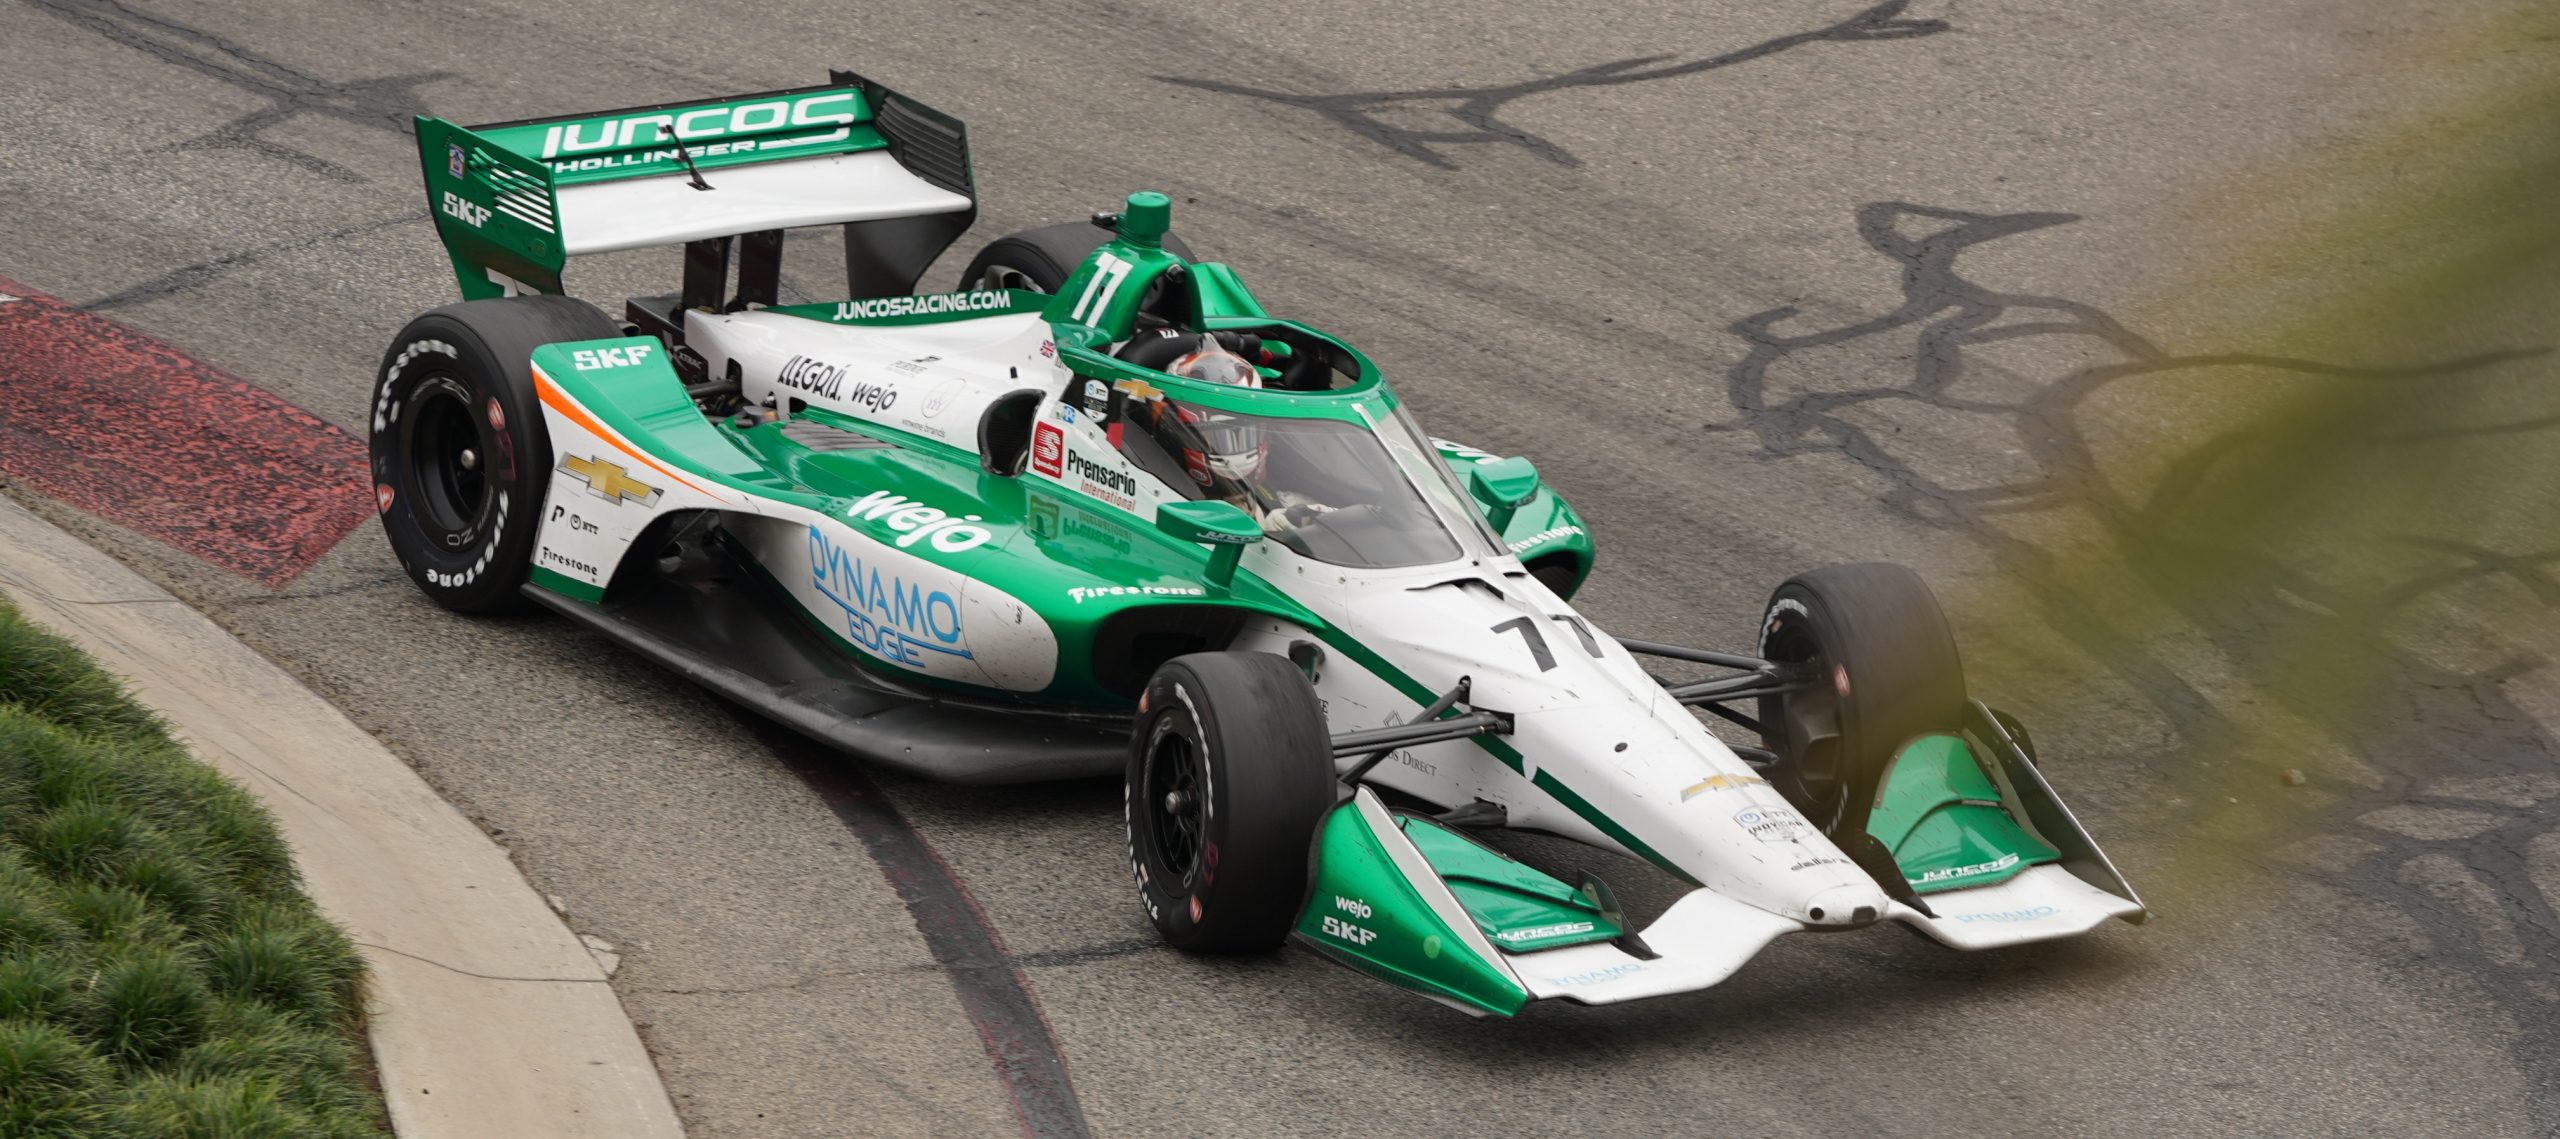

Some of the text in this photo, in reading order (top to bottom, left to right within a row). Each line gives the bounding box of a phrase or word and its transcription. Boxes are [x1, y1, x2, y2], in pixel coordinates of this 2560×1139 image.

[554, 140, 756, 174] HOLLINGER
[442, 191, 492, 229] SKF
[833, 290, 1011, 321] JUNCOSRACING.COM
[573, 345, 652, 371] SKF
[851, 381, 898, 413] wejo
[1067, 447, 1136, 497] Prensario
[1080, 478, 1136, 512] International
[847, 490, 992, 553] wejo
[1506, 524, 1585, 554] Firestone
[541, 545, 599, 576] Firestone
[809, 523, 960, 644] DYNAMO
[1067, 585, 1204, 605] Firestone
[846, 607, 925, 668] EDGE
[1490, 614, 1604, 673] 77
[1335, 895, 1372, 920] wejo
[1322, 915, 1377, 947] SKF
